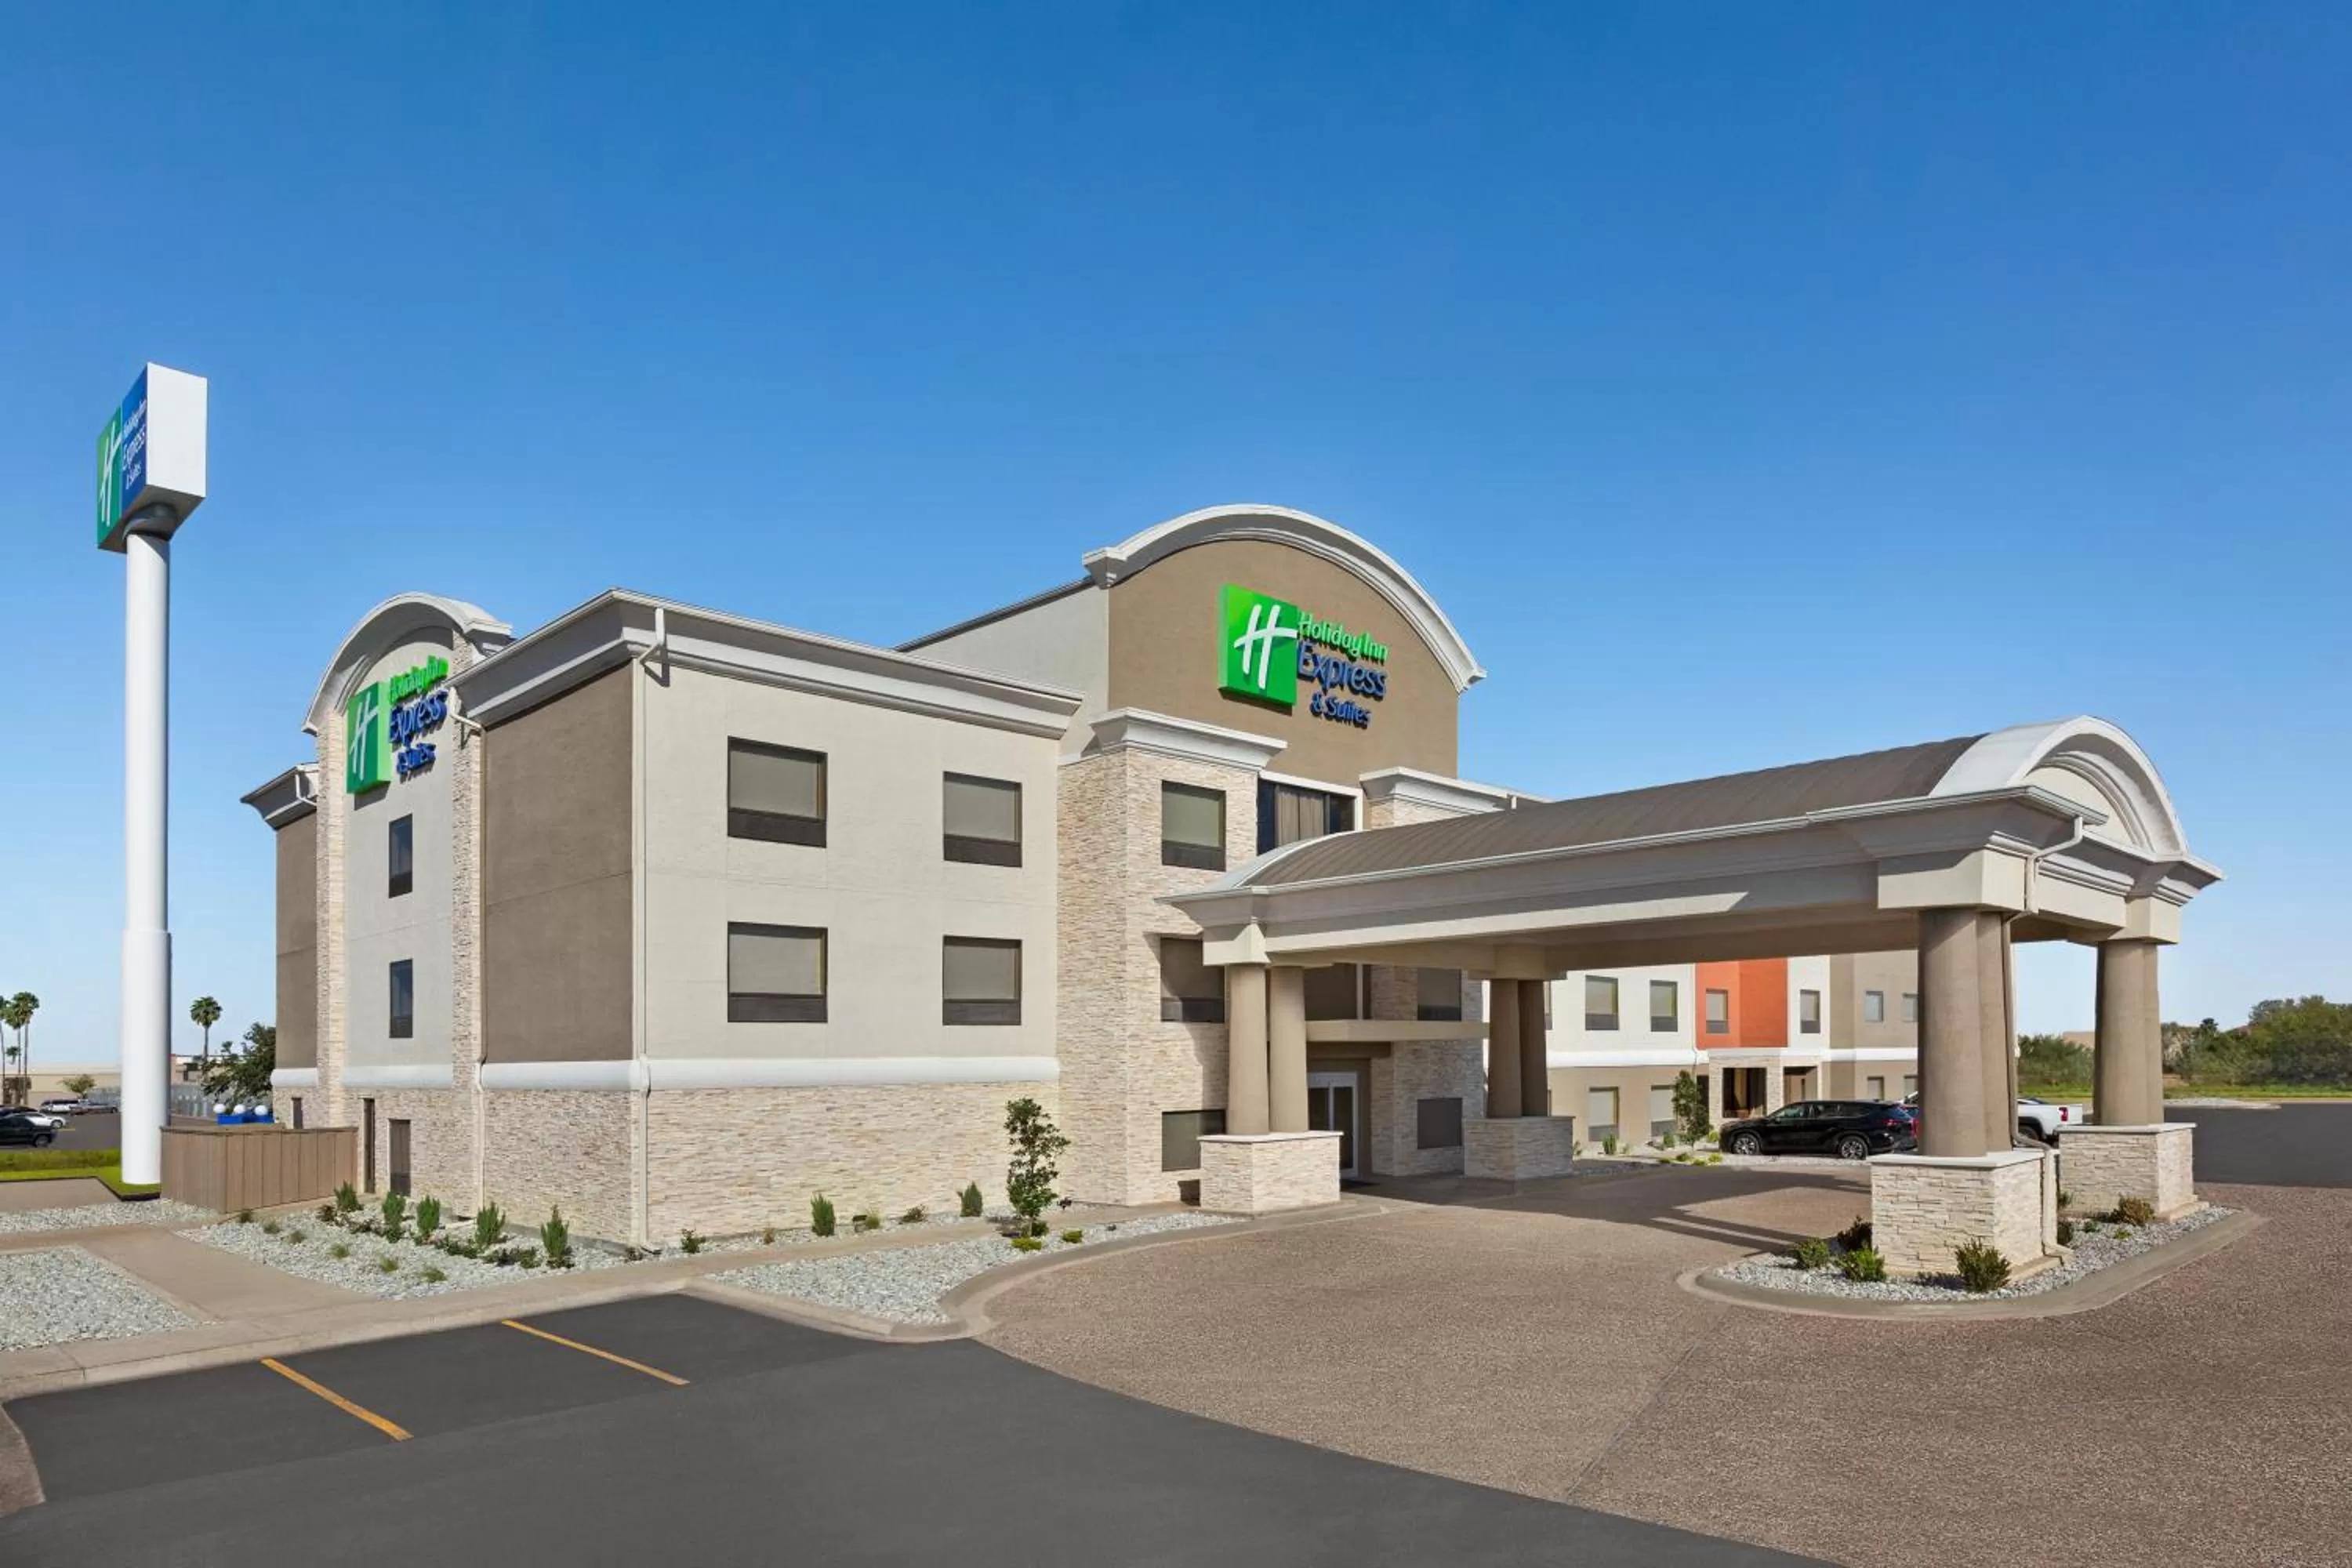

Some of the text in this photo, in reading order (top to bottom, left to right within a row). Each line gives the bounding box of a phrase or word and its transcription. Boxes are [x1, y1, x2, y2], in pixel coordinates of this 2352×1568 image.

[1233, 604, 1298, 690] H
[1298, 611, 1388, 662] Holiday Inn
[1297, 640, 1389, 698] Express
[350, 691, 379, 782] H
[389, 691, 448, 750] Express
[1310, 690, 1372, 727] & Suites
